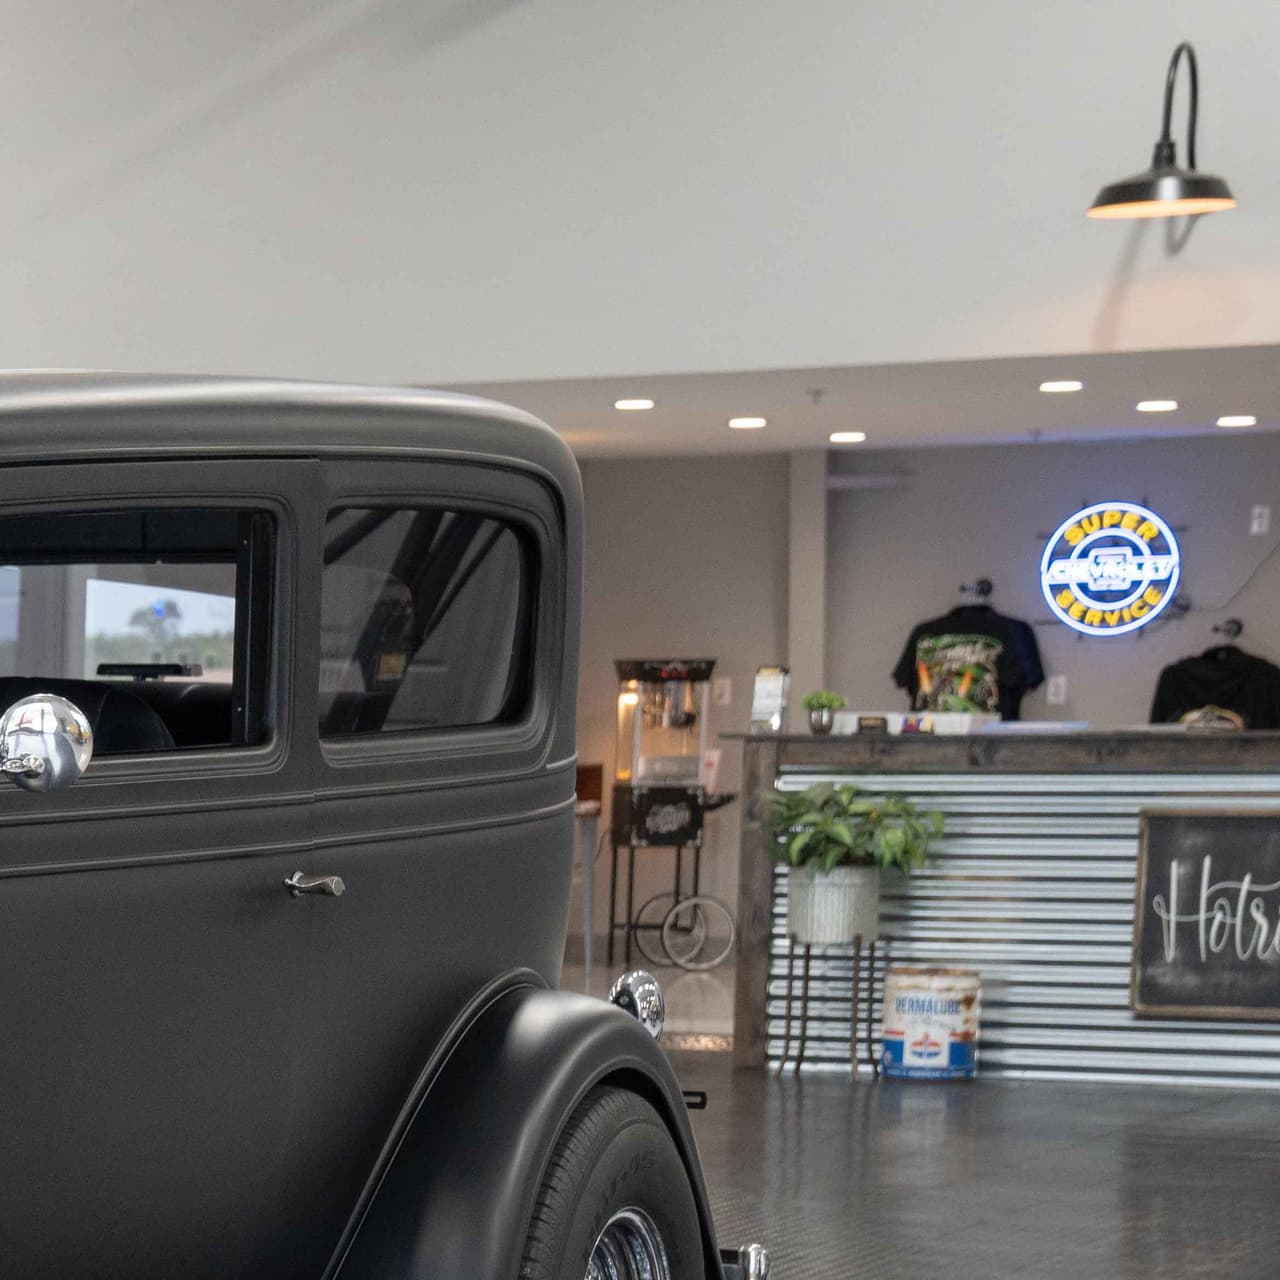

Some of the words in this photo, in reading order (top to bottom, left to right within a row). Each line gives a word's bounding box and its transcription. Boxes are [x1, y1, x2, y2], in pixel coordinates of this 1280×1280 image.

[1064, 511, 1159, 546] SUPER
[1050, 557, 1172, 583] CHEVROLET
[1056, 585, 1162, 626] SERVICE
[1153, 855, 1280, 963] Hotr
